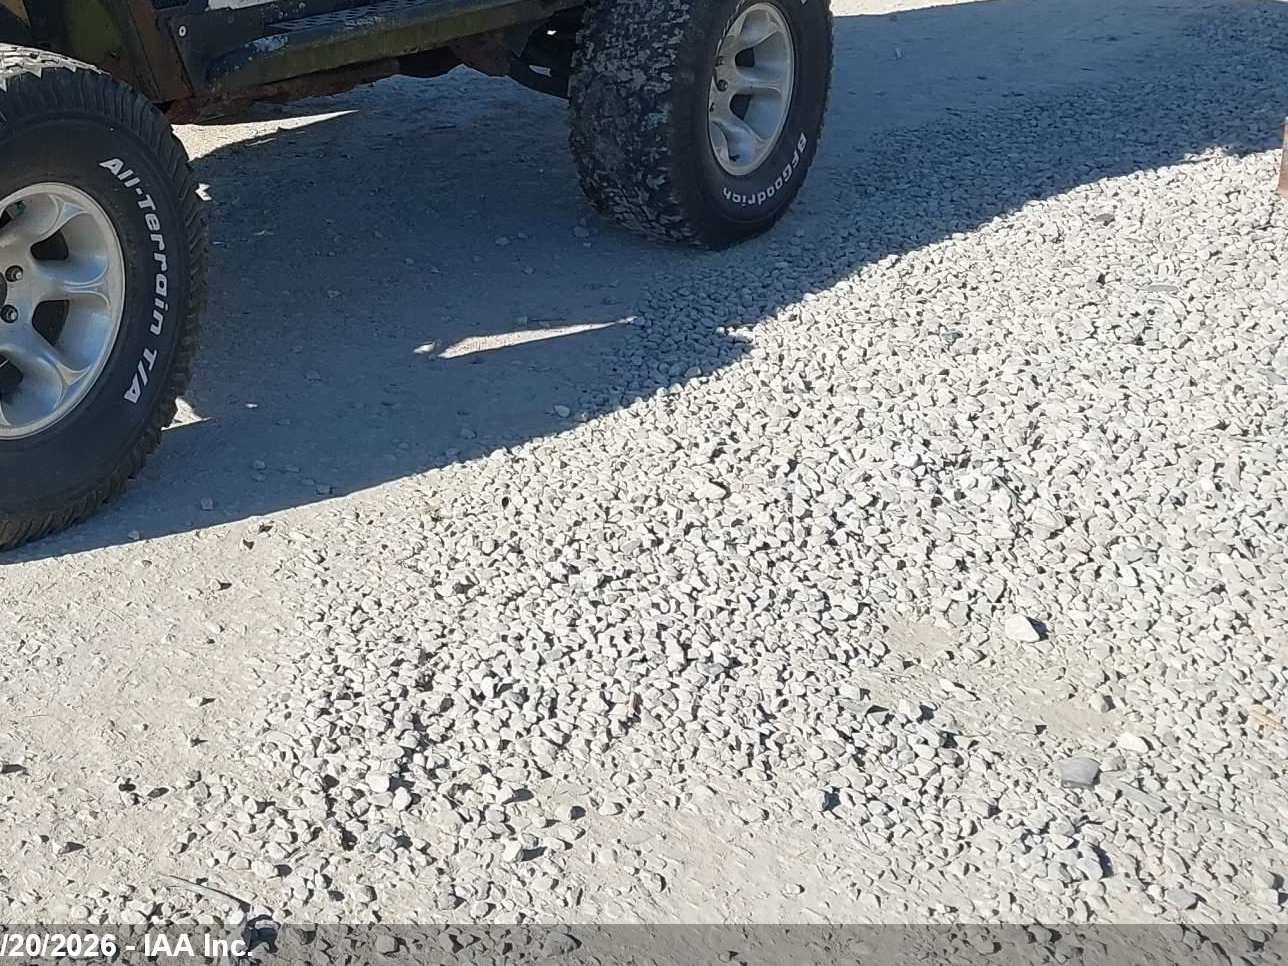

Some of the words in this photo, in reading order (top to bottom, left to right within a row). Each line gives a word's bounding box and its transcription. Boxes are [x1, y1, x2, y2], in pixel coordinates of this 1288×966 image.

[722, 132, 808, 208] BFGoodrich
[99, 157, 169, 336] All-Terrain
[124, 347, 158, 404] T/A
